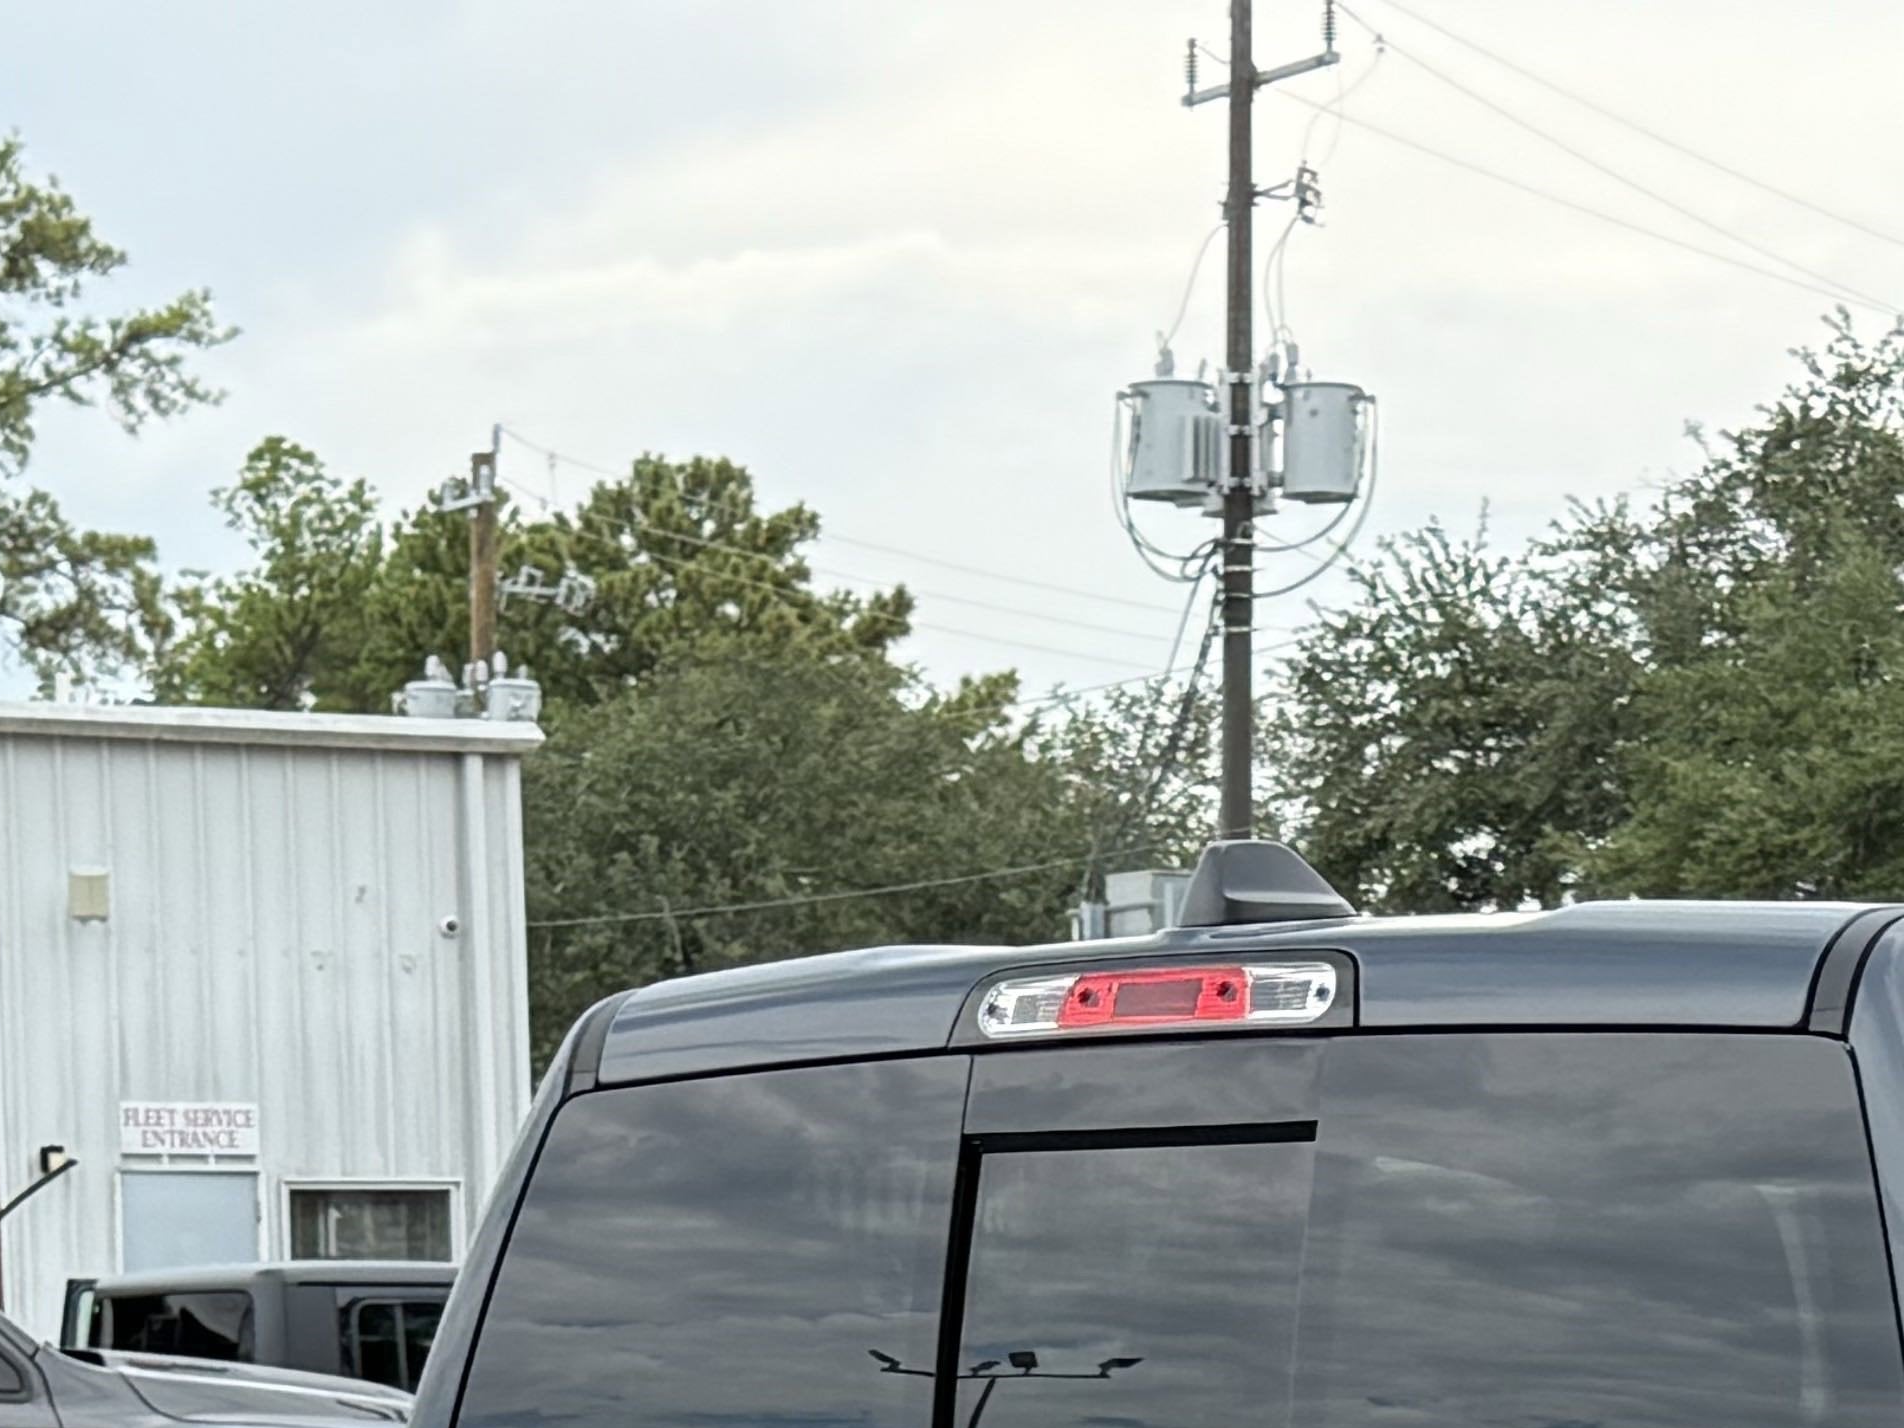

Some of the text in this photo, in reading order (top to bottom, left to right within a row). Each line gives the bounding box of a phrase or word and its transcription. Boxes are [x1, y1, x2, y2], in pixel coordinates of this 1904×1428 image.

[123, 1107, 256, 1129] FLEET SERVICE
[141, 1129, 240, 1150] ENTRANCE
